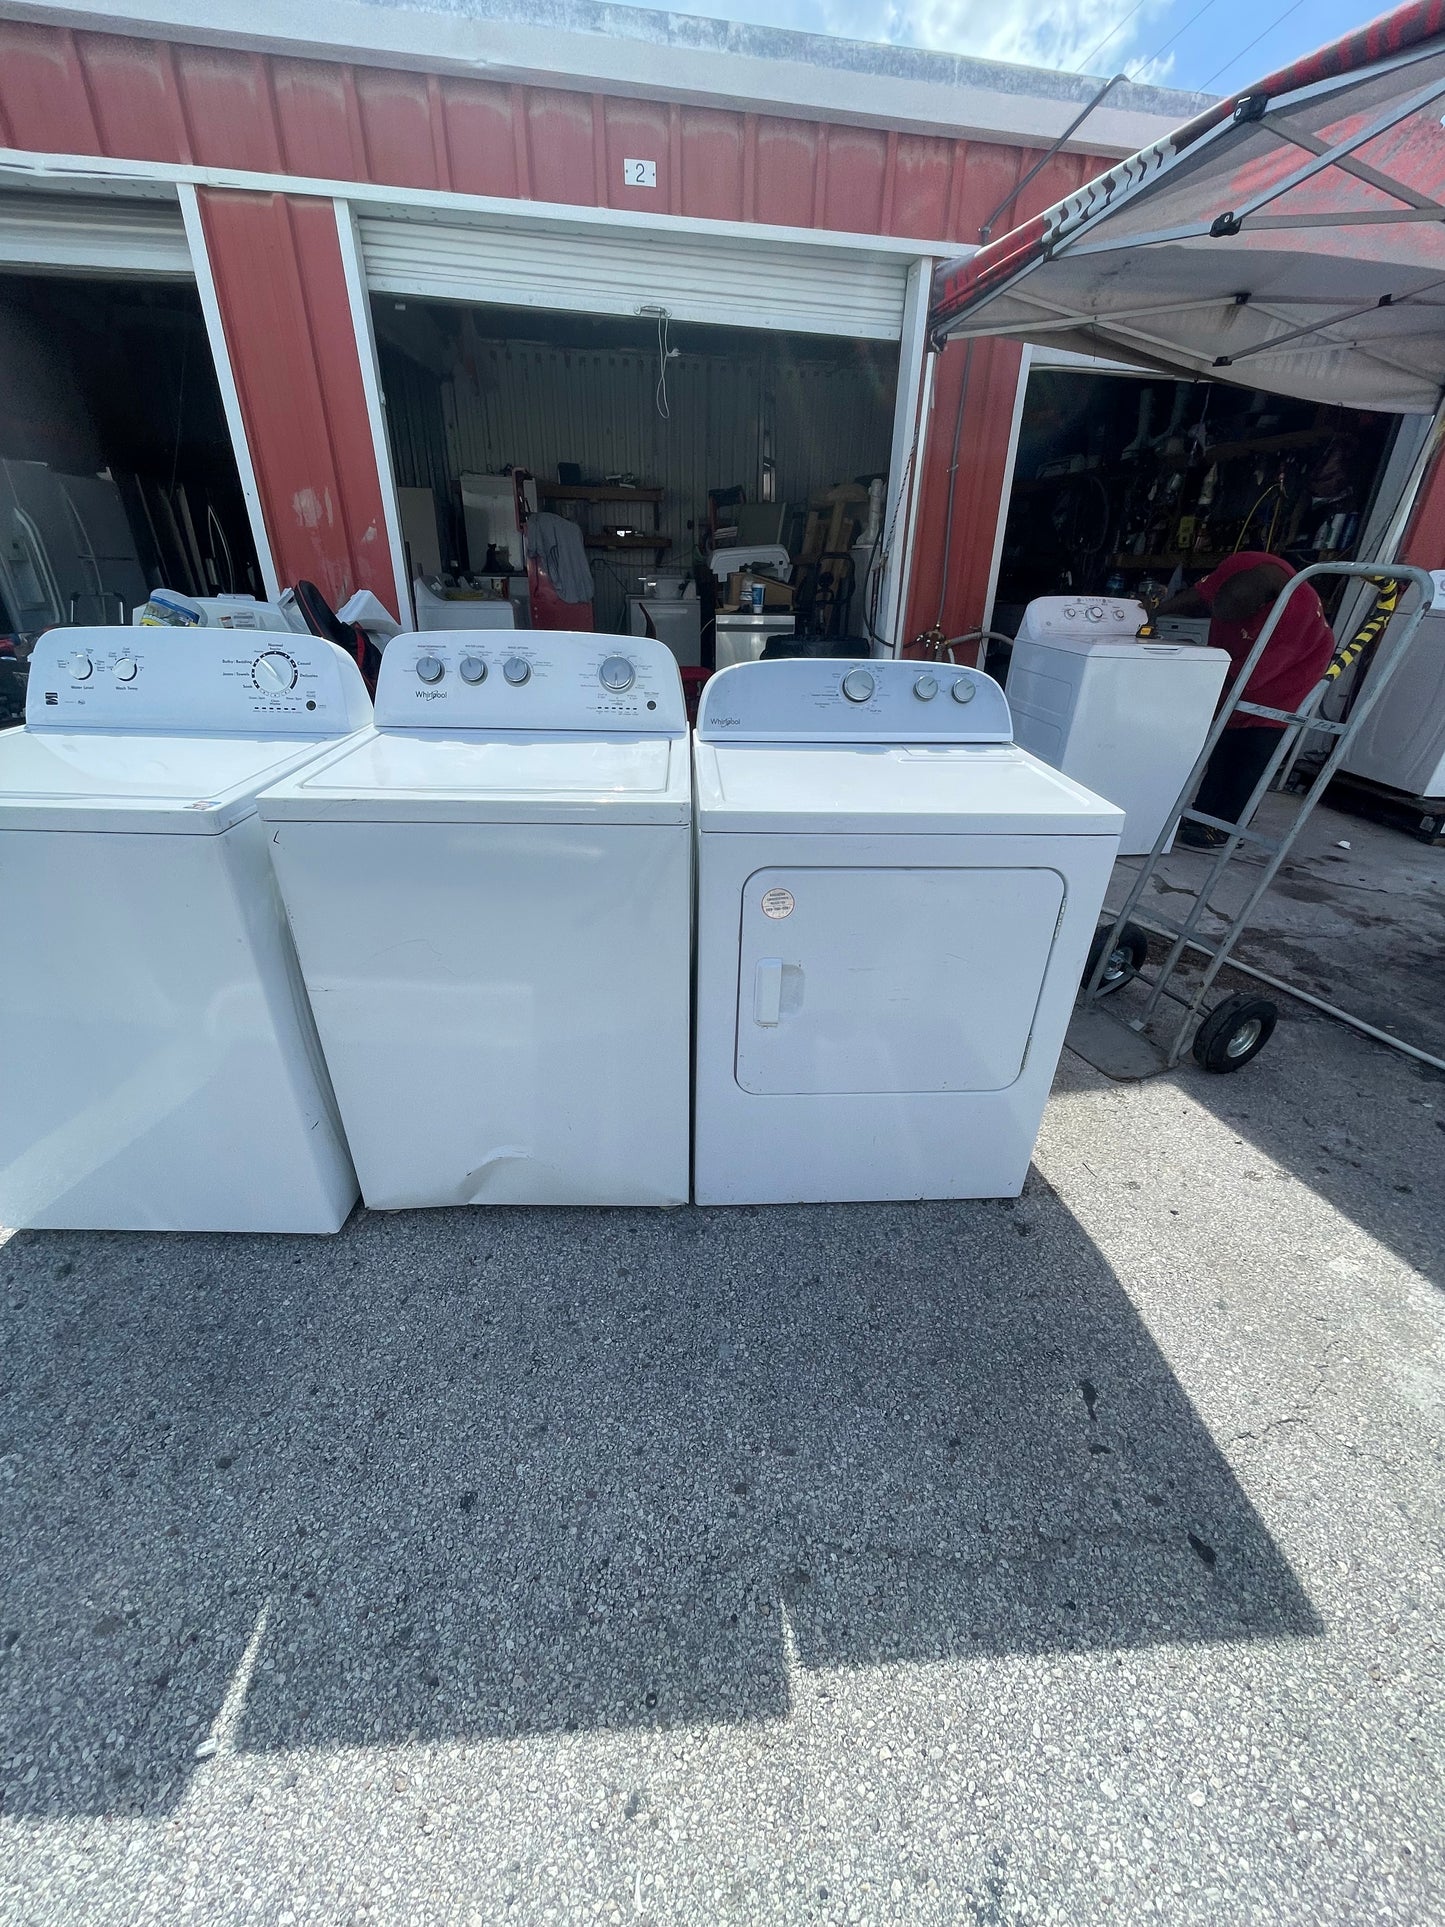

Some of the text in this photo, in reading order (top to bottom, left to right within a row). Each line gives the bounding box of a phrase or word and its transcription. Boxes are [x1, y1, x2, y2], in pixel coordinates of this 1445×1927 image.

[635, 163, 645, 183] 2
[415, 690, 447, 701] Whirlpool
[710, 717, 741, 728] Whirlpool
